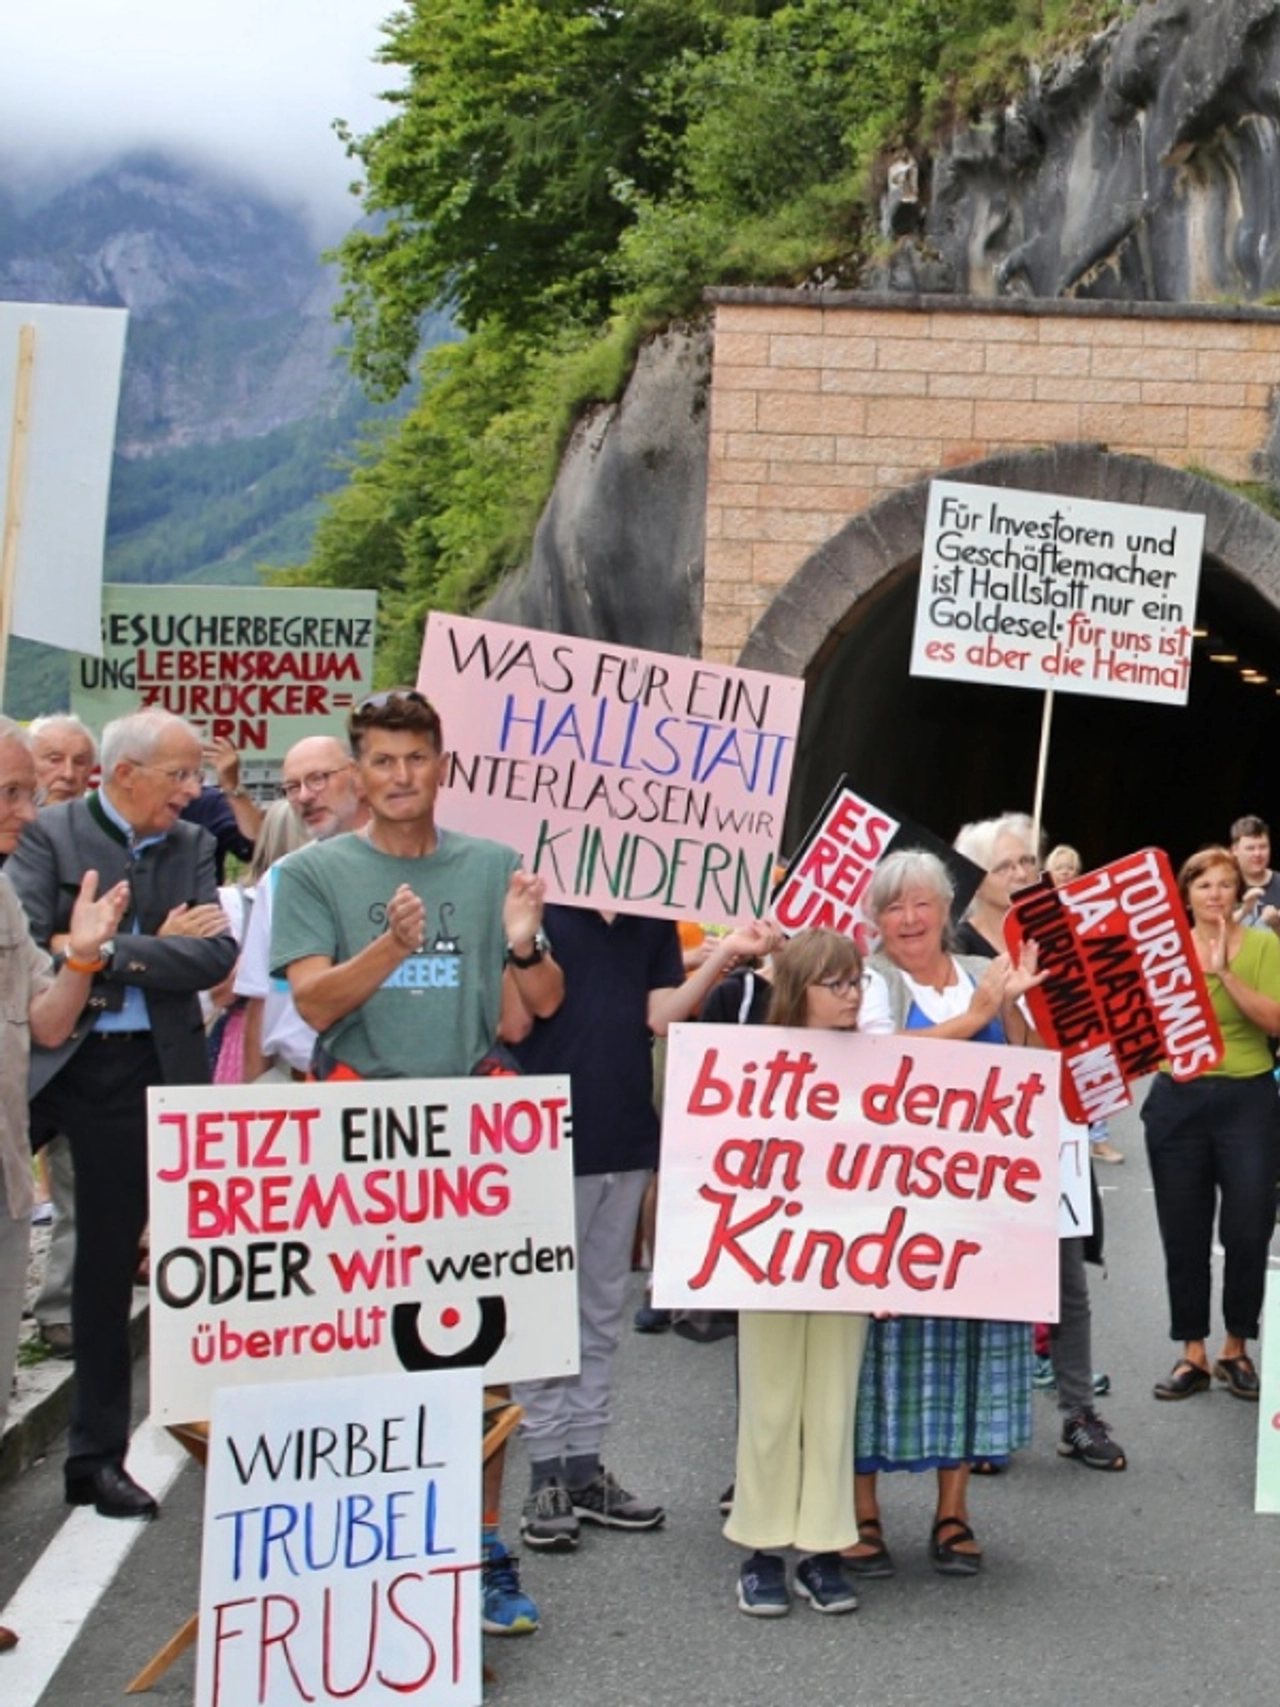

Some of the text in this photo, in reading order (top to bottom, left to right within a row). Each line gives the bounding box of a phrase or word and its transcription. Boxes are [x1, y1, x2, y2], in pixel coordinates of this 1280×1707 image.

[936, 531, 1177, 590] Geschäftemacher
[939, 497, 1177, 556] Für Investoren und
[932, 564, 1183, 622] ist Hallstatt nur ein
[81, 649, 361, 689] UNG LEBENSRAUM
[925, 634, 1192, 690] es aber die Heimat
[1067, 611, 1106, 649] für
[1111, 629, 1151, 653] uns
[1158, 625, 1192, 658] ist
[448, 628, 770, 729] WAS FÜR EIN
[499, 694, 792, 796] HALLSTATT
[439, 751, 774, 838] NTERLASSEN WIR
[825, 797, 891, 861] ES
[533, 819, 774, 919] KINDERN
[379, 957, 460, 988] REECE
[1010, 871, 1104, 1048] TOURISMUS
[1114, 852, 1217, 1076] TOURISMUS
[686, 1048, 1046, 1138] bitte denkt
[156, 1109, 321, 1182] JETZT
[340, 1104, 451, 1163] EINE
[712, 1137, 804, 1191] an
[826, 1142, 1042, 1201] unsere
[187, 1163, 510, 1239] BREMSUNG
[687, 1184, 981, 1290] Kinder
[156, 1234, 574, 1309] ODER wir werden
[190, 1305, 386, 1366] überrollt
[227, 1404, 446, 1485] WIRBEL
[214, 1479, 457, 1581] TRUBEL
[212, 1564, 483, 1707] FRUST
